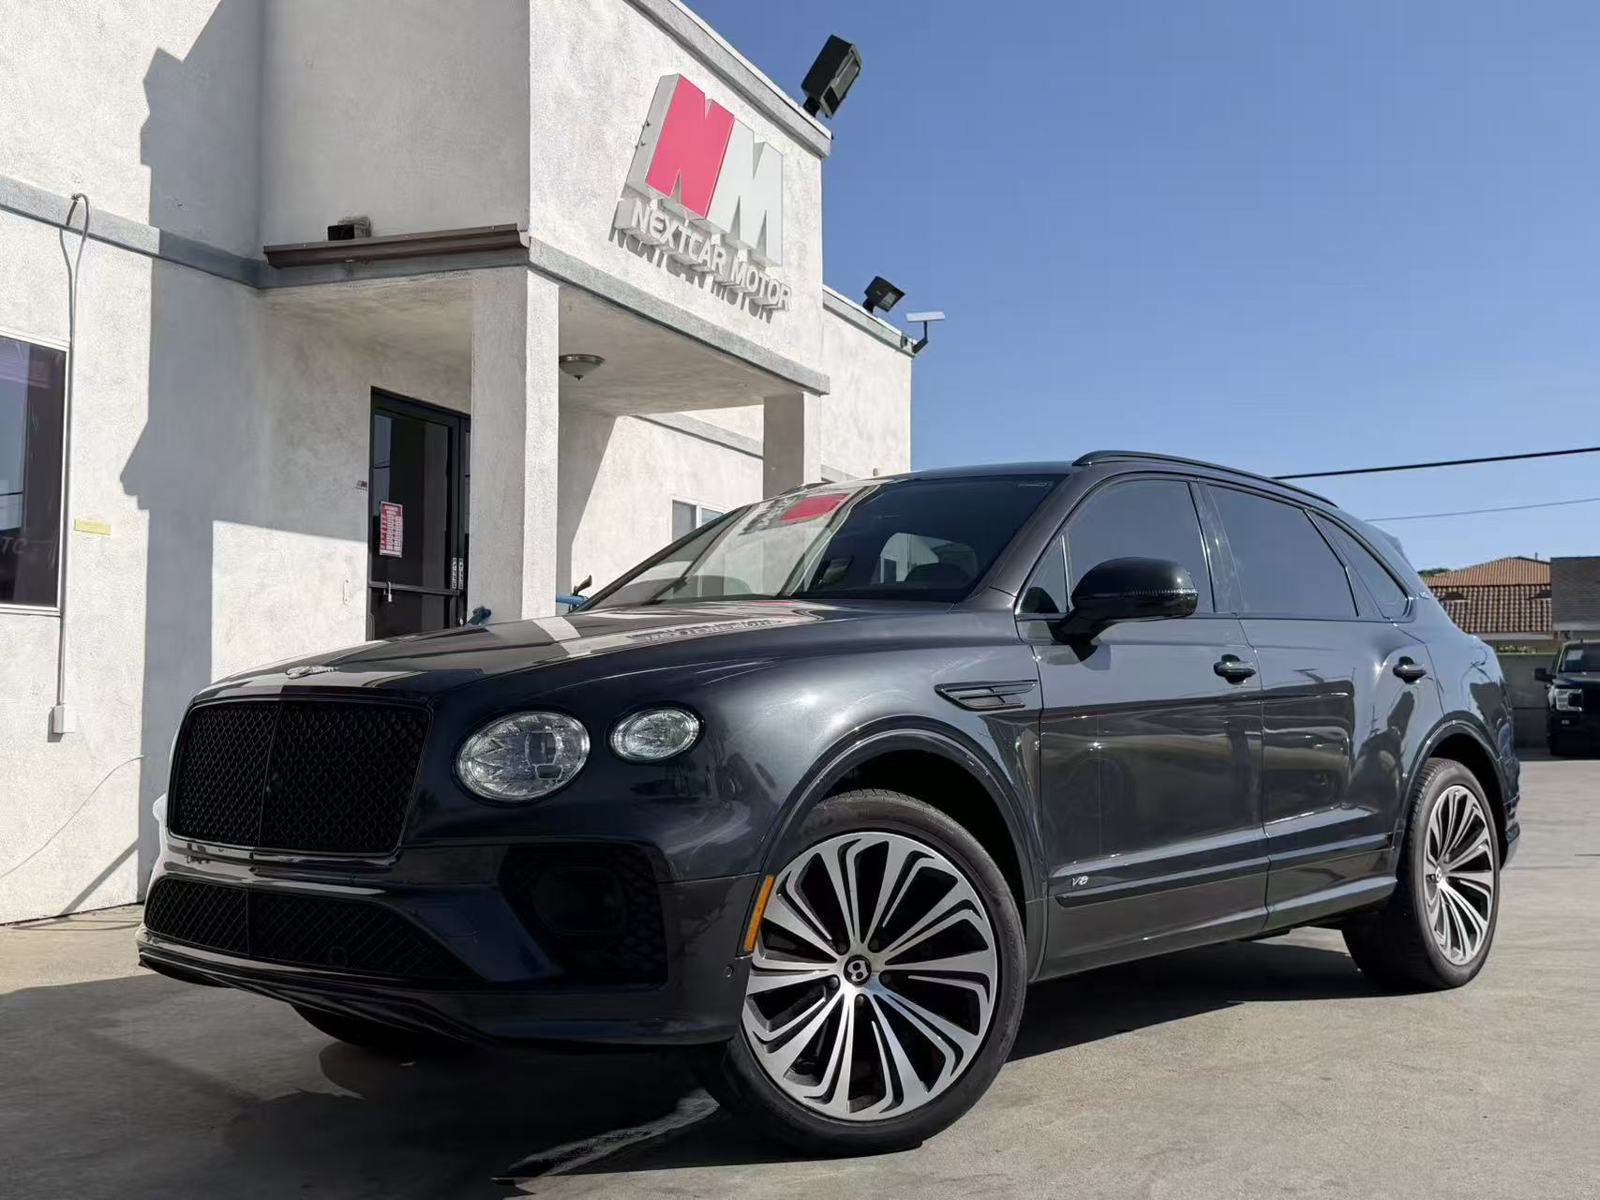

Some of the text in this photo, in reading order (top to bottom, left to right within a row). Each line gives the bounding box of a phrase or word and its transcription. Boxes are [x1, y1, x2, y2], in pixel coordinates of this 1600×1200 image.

[644, 73, 784, 267] NM
[630, 200, 792, 312] NEXTCAR MOTOR
[1072, 875, 1089, 887] V8
